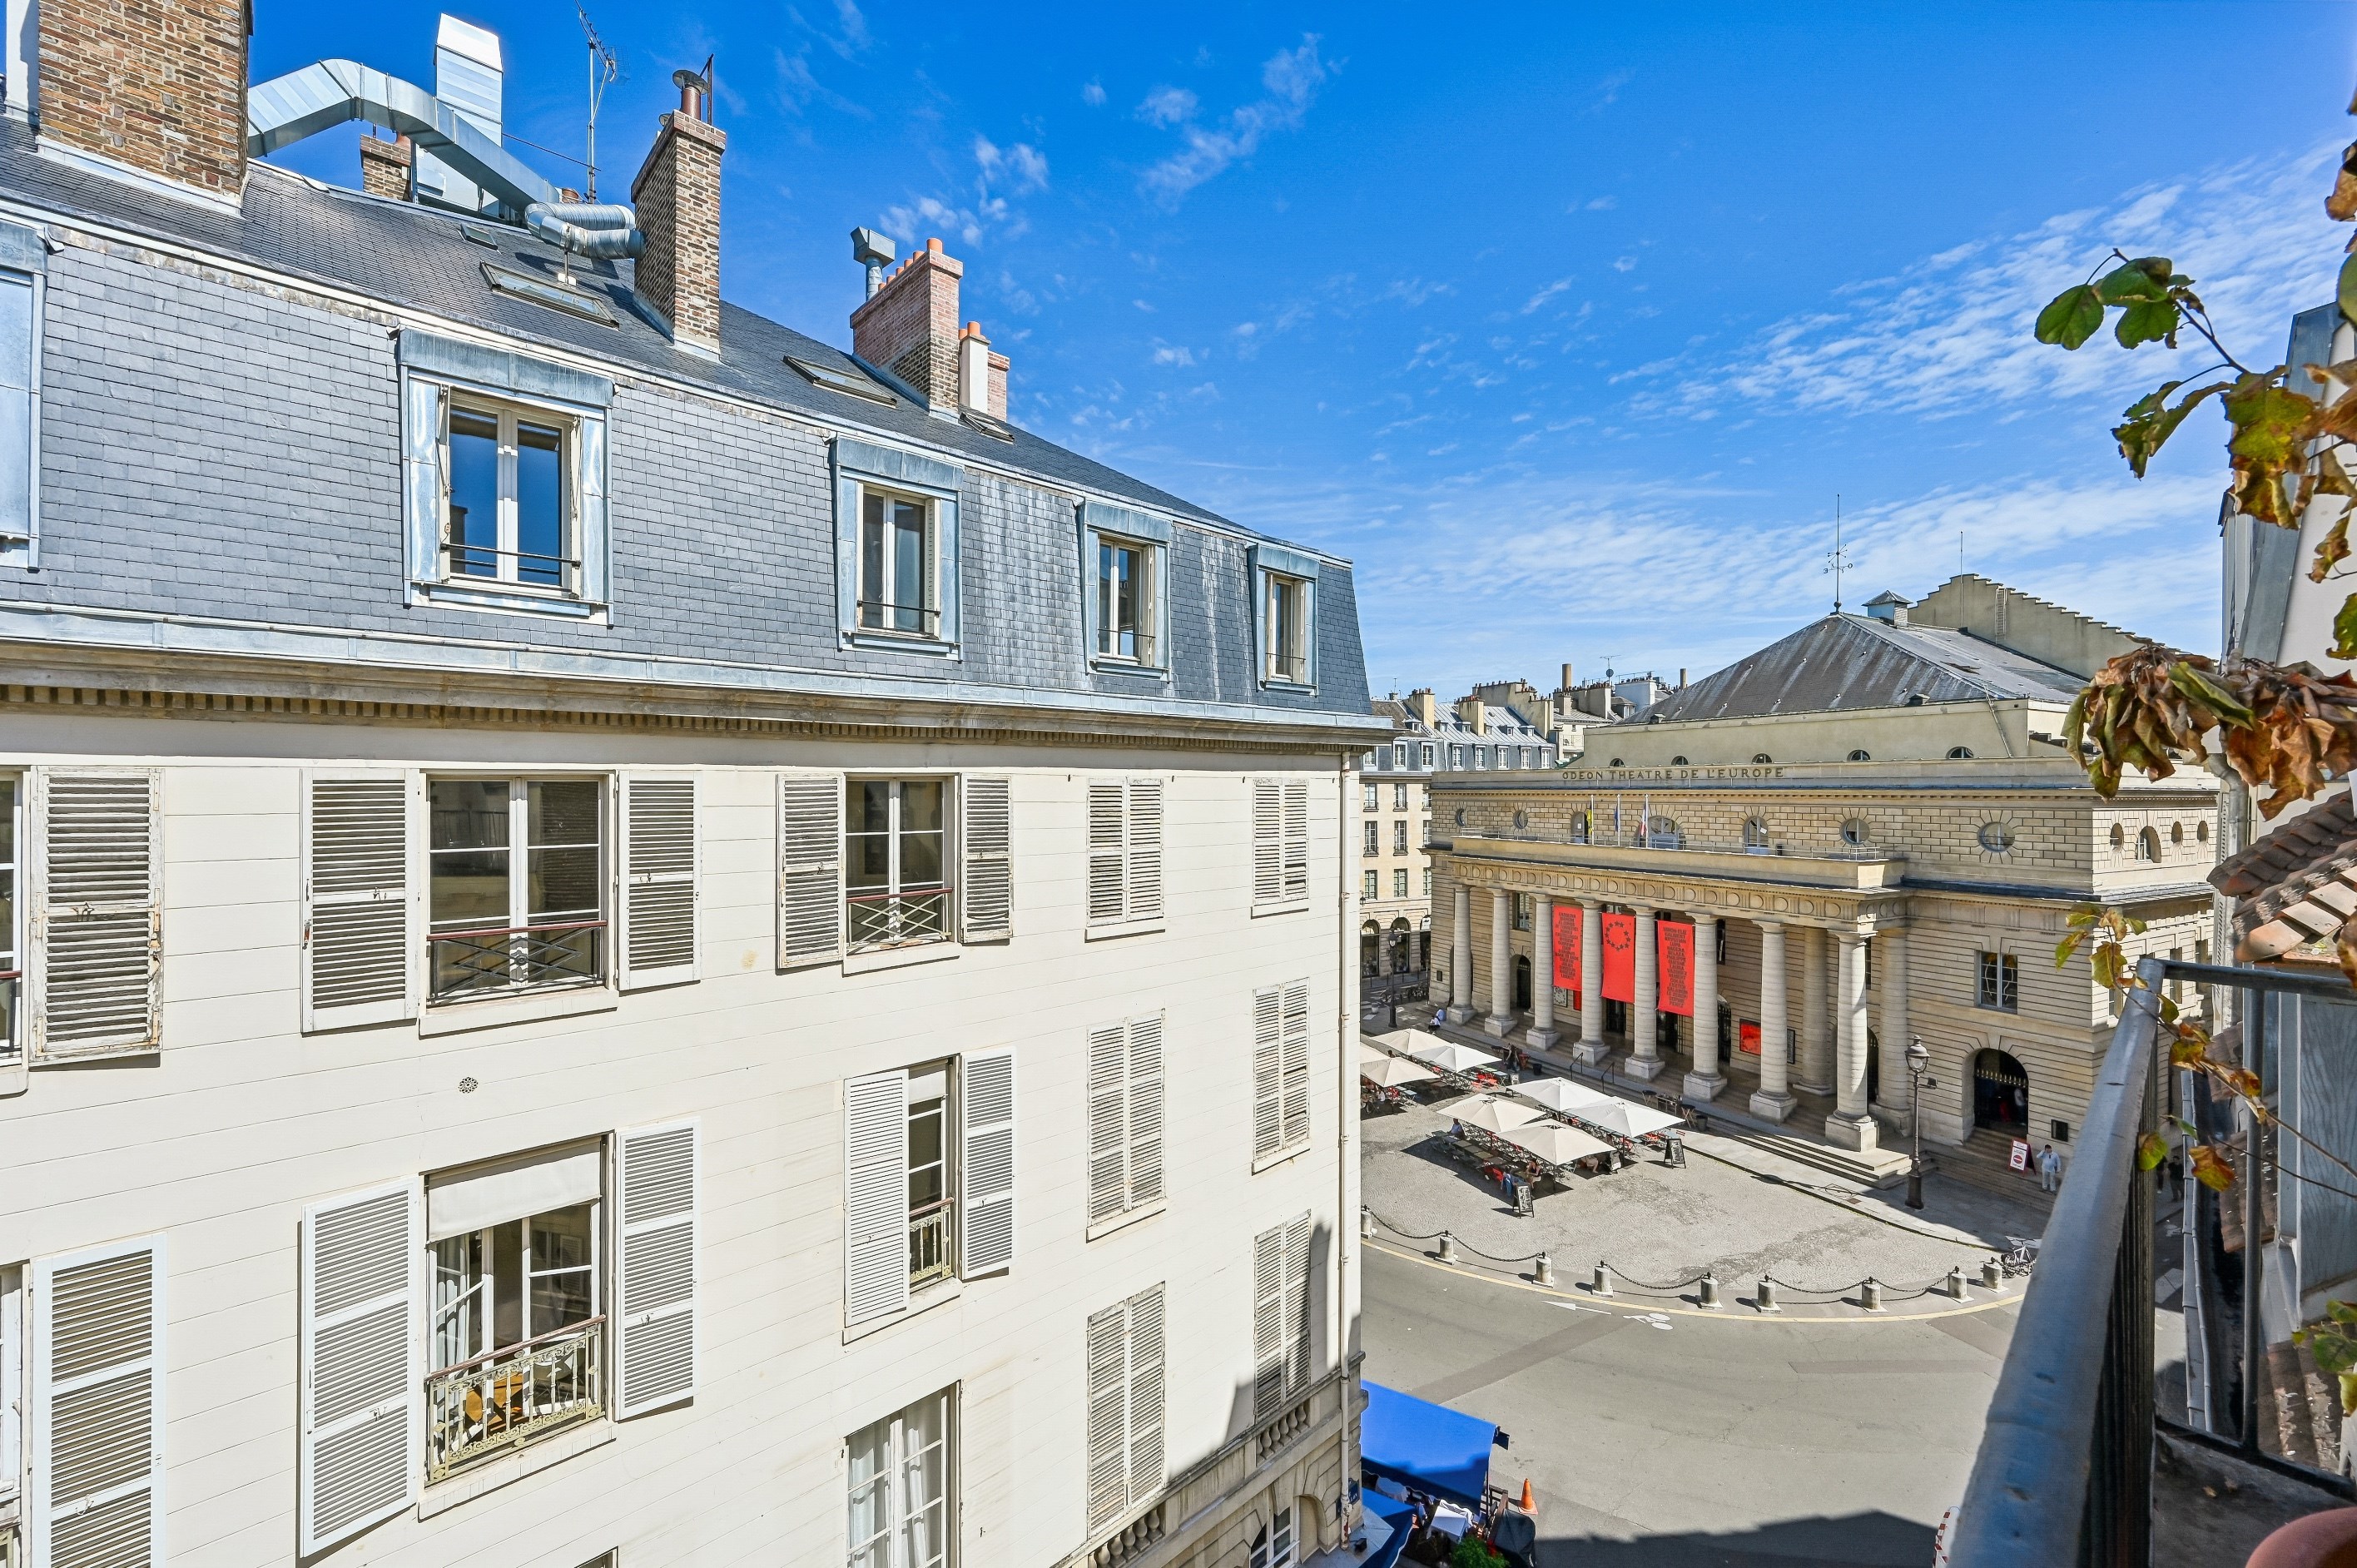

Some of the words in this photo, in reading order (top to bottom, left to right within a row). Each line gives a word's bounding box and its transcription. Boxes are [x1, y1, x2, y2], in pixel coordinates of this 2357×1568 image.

[1562, 771, 1603, 780] ODEON
[1610, 770, 1673, 780] THEATRE
[1681, 769, 1699, 779] DE
[1707, 767, 1784, 778] L'EUROPE
